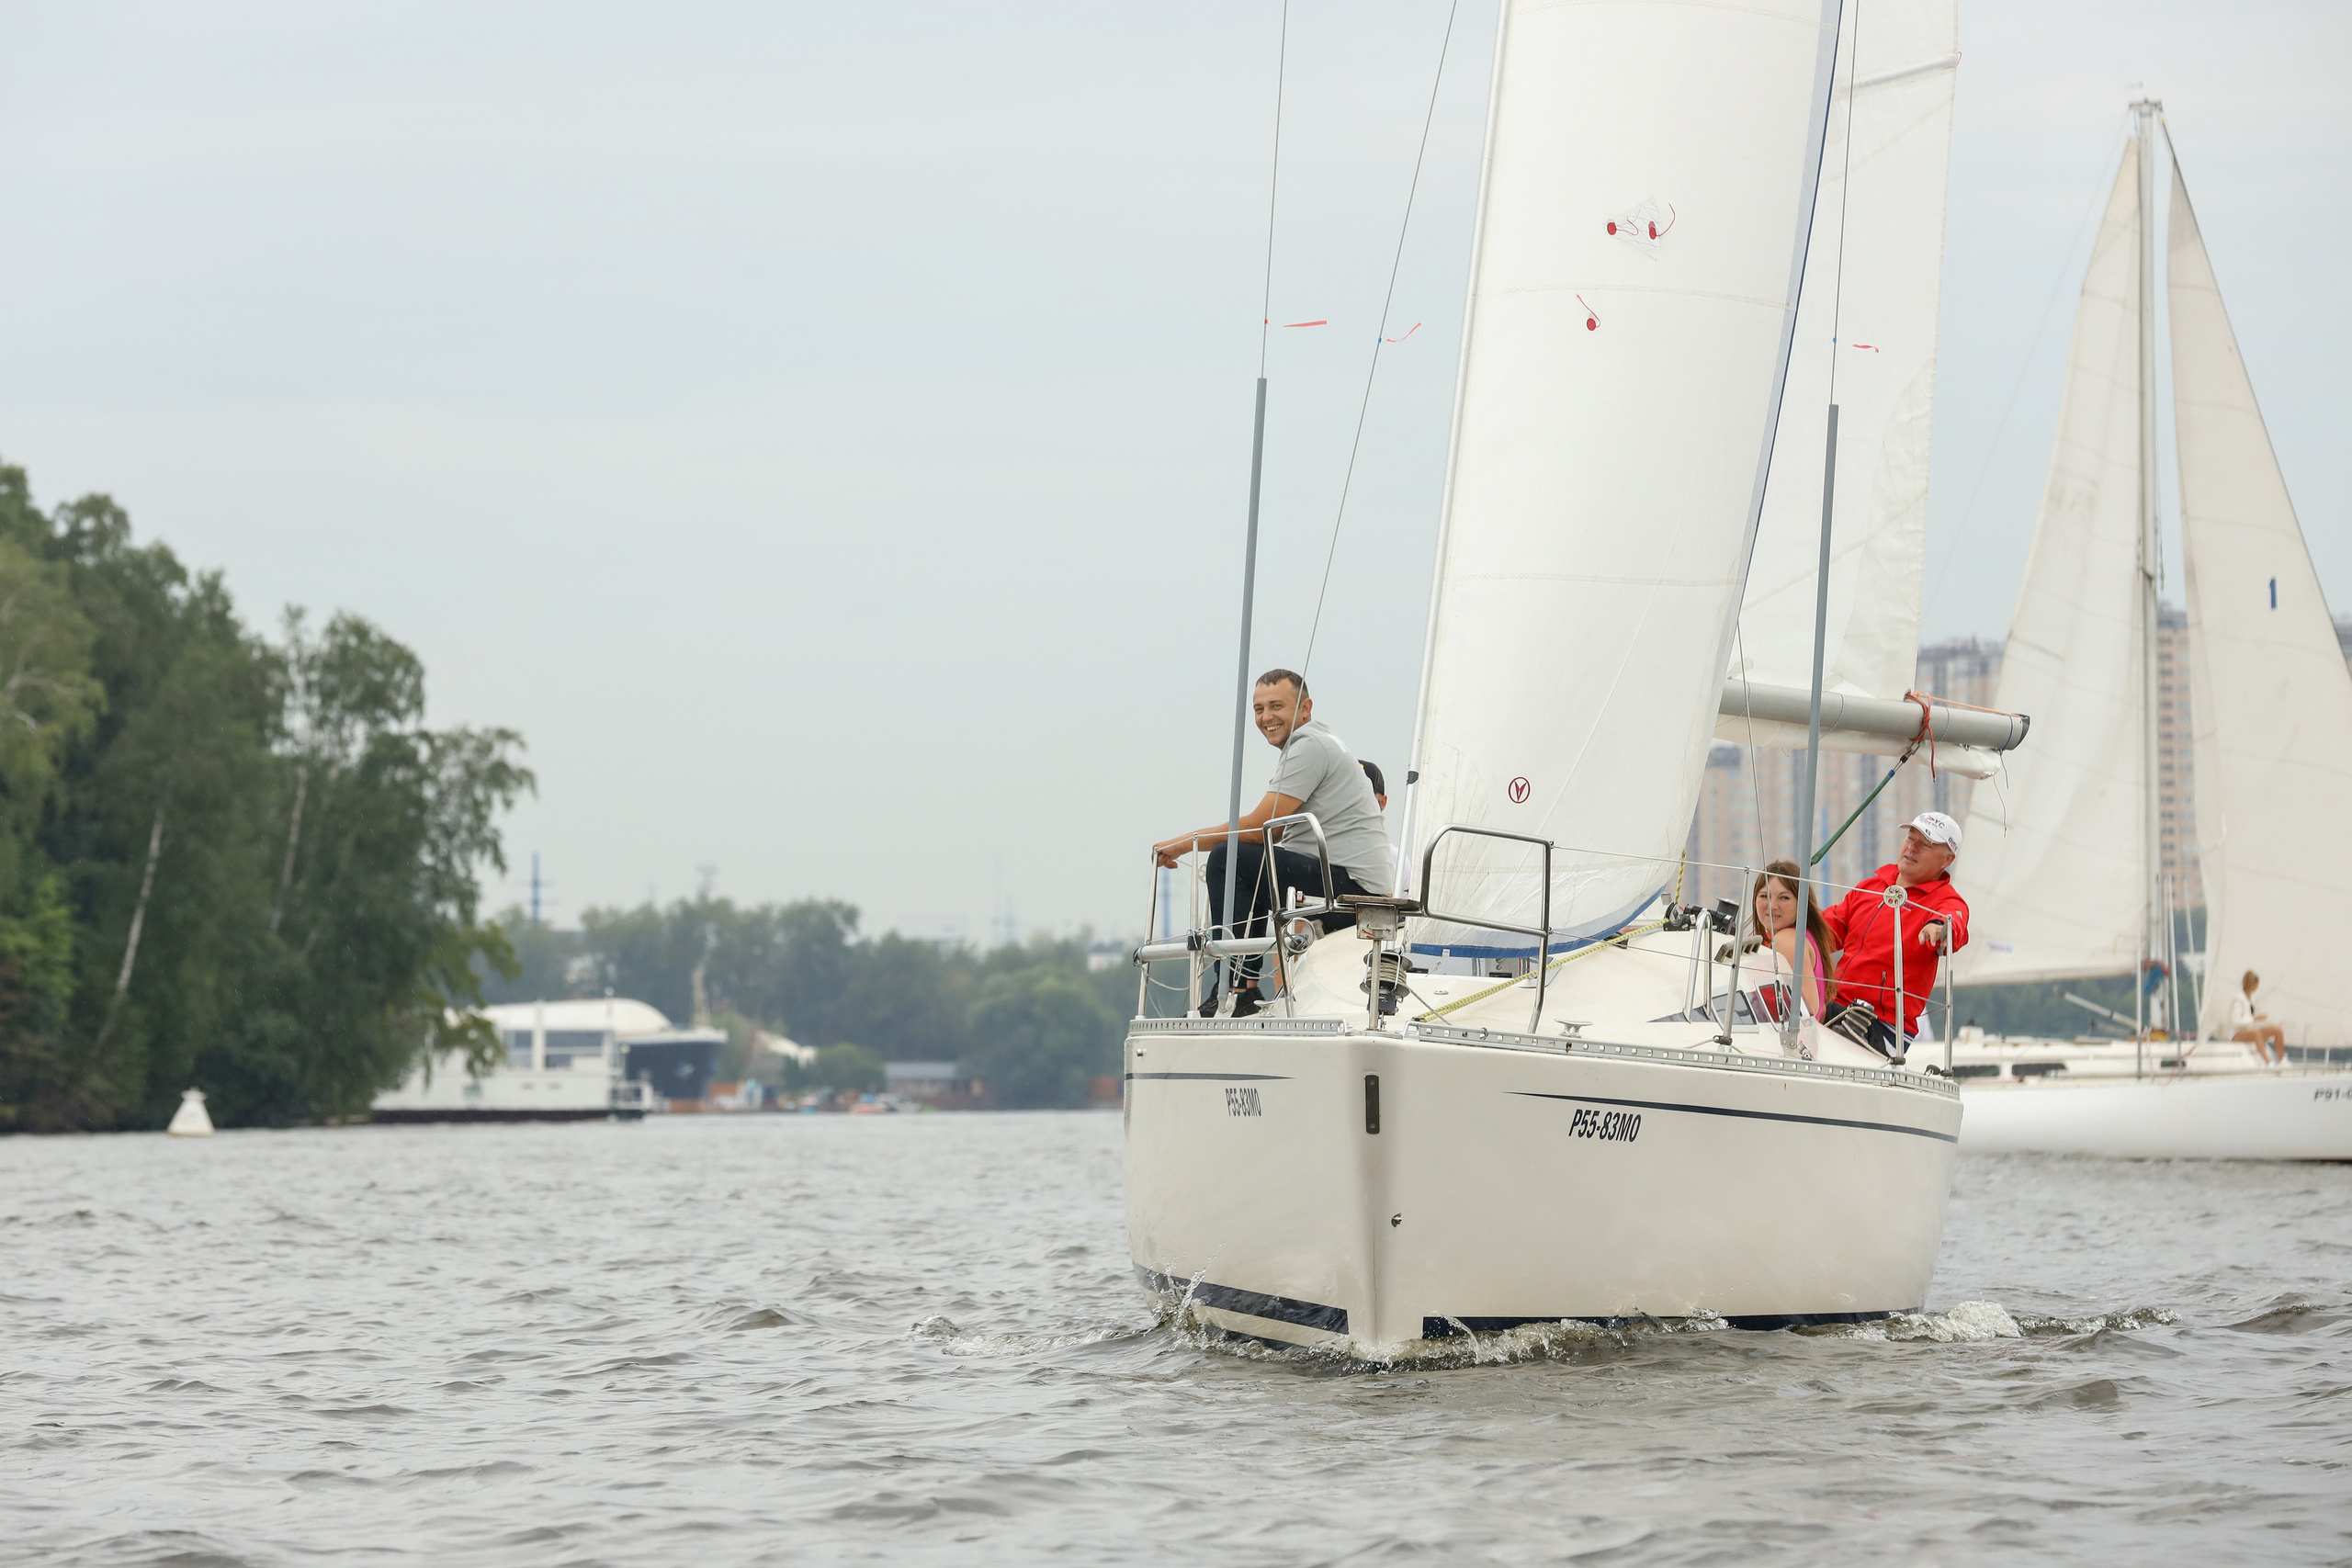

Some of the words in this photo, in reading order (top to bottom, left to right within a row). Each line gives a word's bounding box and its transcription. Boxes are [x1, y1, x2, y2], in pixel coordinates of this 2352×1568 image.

[2269, 578, 2277, 610] 1
[1225, 1088, 1261, 1117] P55-83MO
[1568, 1109, 1642, 1143] P55-83MO
